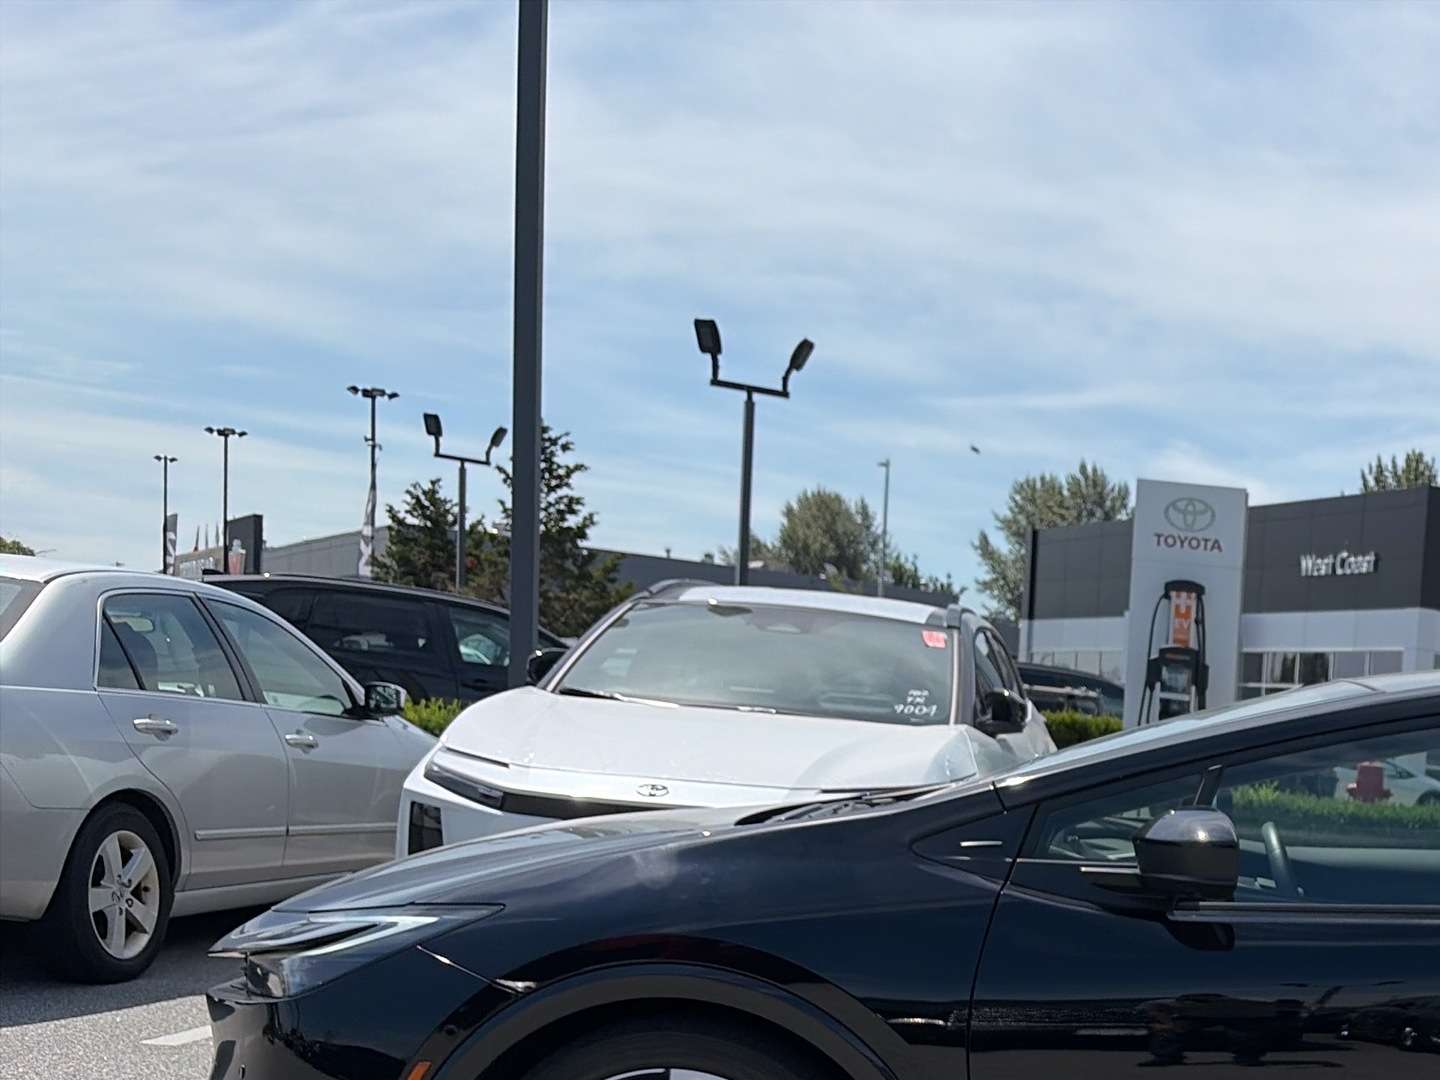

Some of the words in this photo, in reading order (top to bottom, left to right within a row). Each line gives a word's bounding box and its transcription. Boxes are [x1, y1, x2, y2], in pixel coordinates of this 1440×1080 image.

[1154, 532, 1223, 553] TOYOTA
[1300, 553, 1334, 577] West
[1335, 549, 1375, 575] Coast
